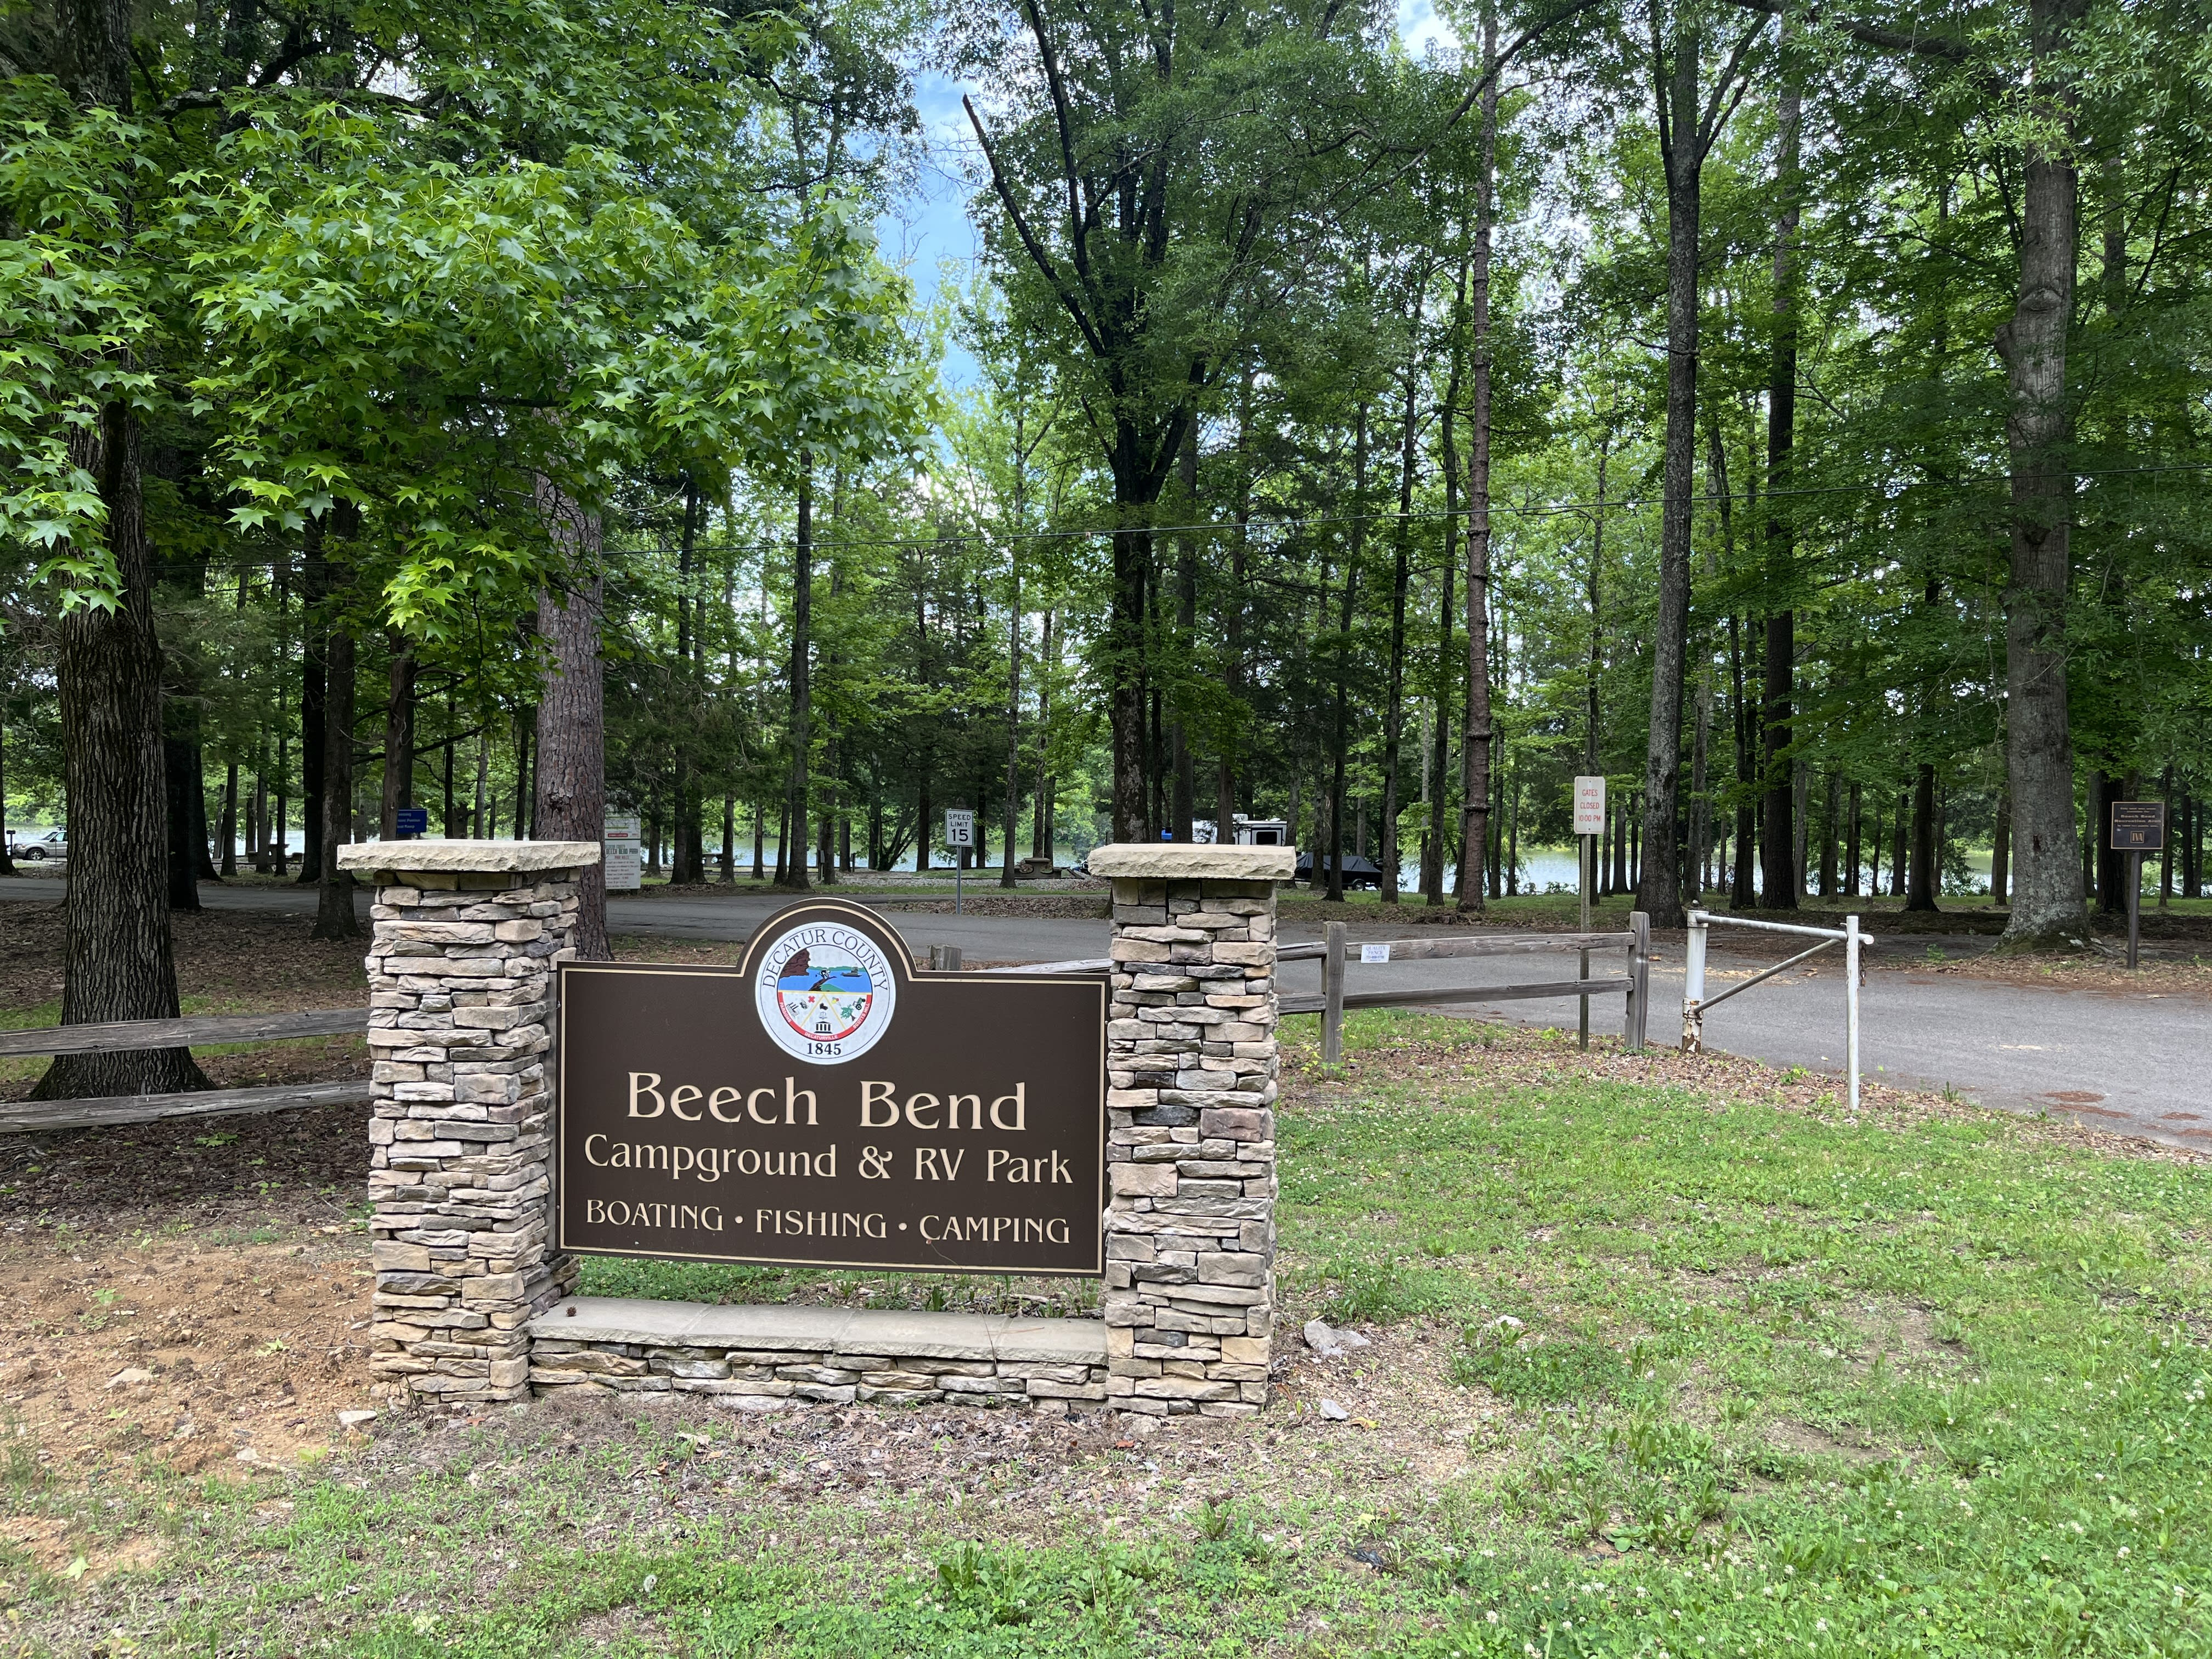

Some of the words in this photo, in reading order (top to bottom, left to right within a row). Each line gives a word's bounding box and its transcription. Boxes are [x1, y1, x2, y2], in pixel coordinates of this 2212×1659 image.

[952, 828, 968, 842] 15
[763, 929, 826, 988] DECATUR
[832, 931, 888, 990] COUNTY
[805, 1032, 839, 1041] DECATURVILLE
[807, 1042, 841, 1056] 1845
[627, 1072, 819, 1126] Beech
[860, 1081, 1026, 1131] Bend
[585, 1133, 837, 1182] Campground
[858, 1146, 893, 1179] &
[915, 1148, 965, 1181] RV
[987, 1149, 1074, 1183] Park
[587, 1199, 723, 1231] BOATING
[756, 1209, 887, 1238] FISHING
[919, 1215, 1070, 1244] CAMPING
